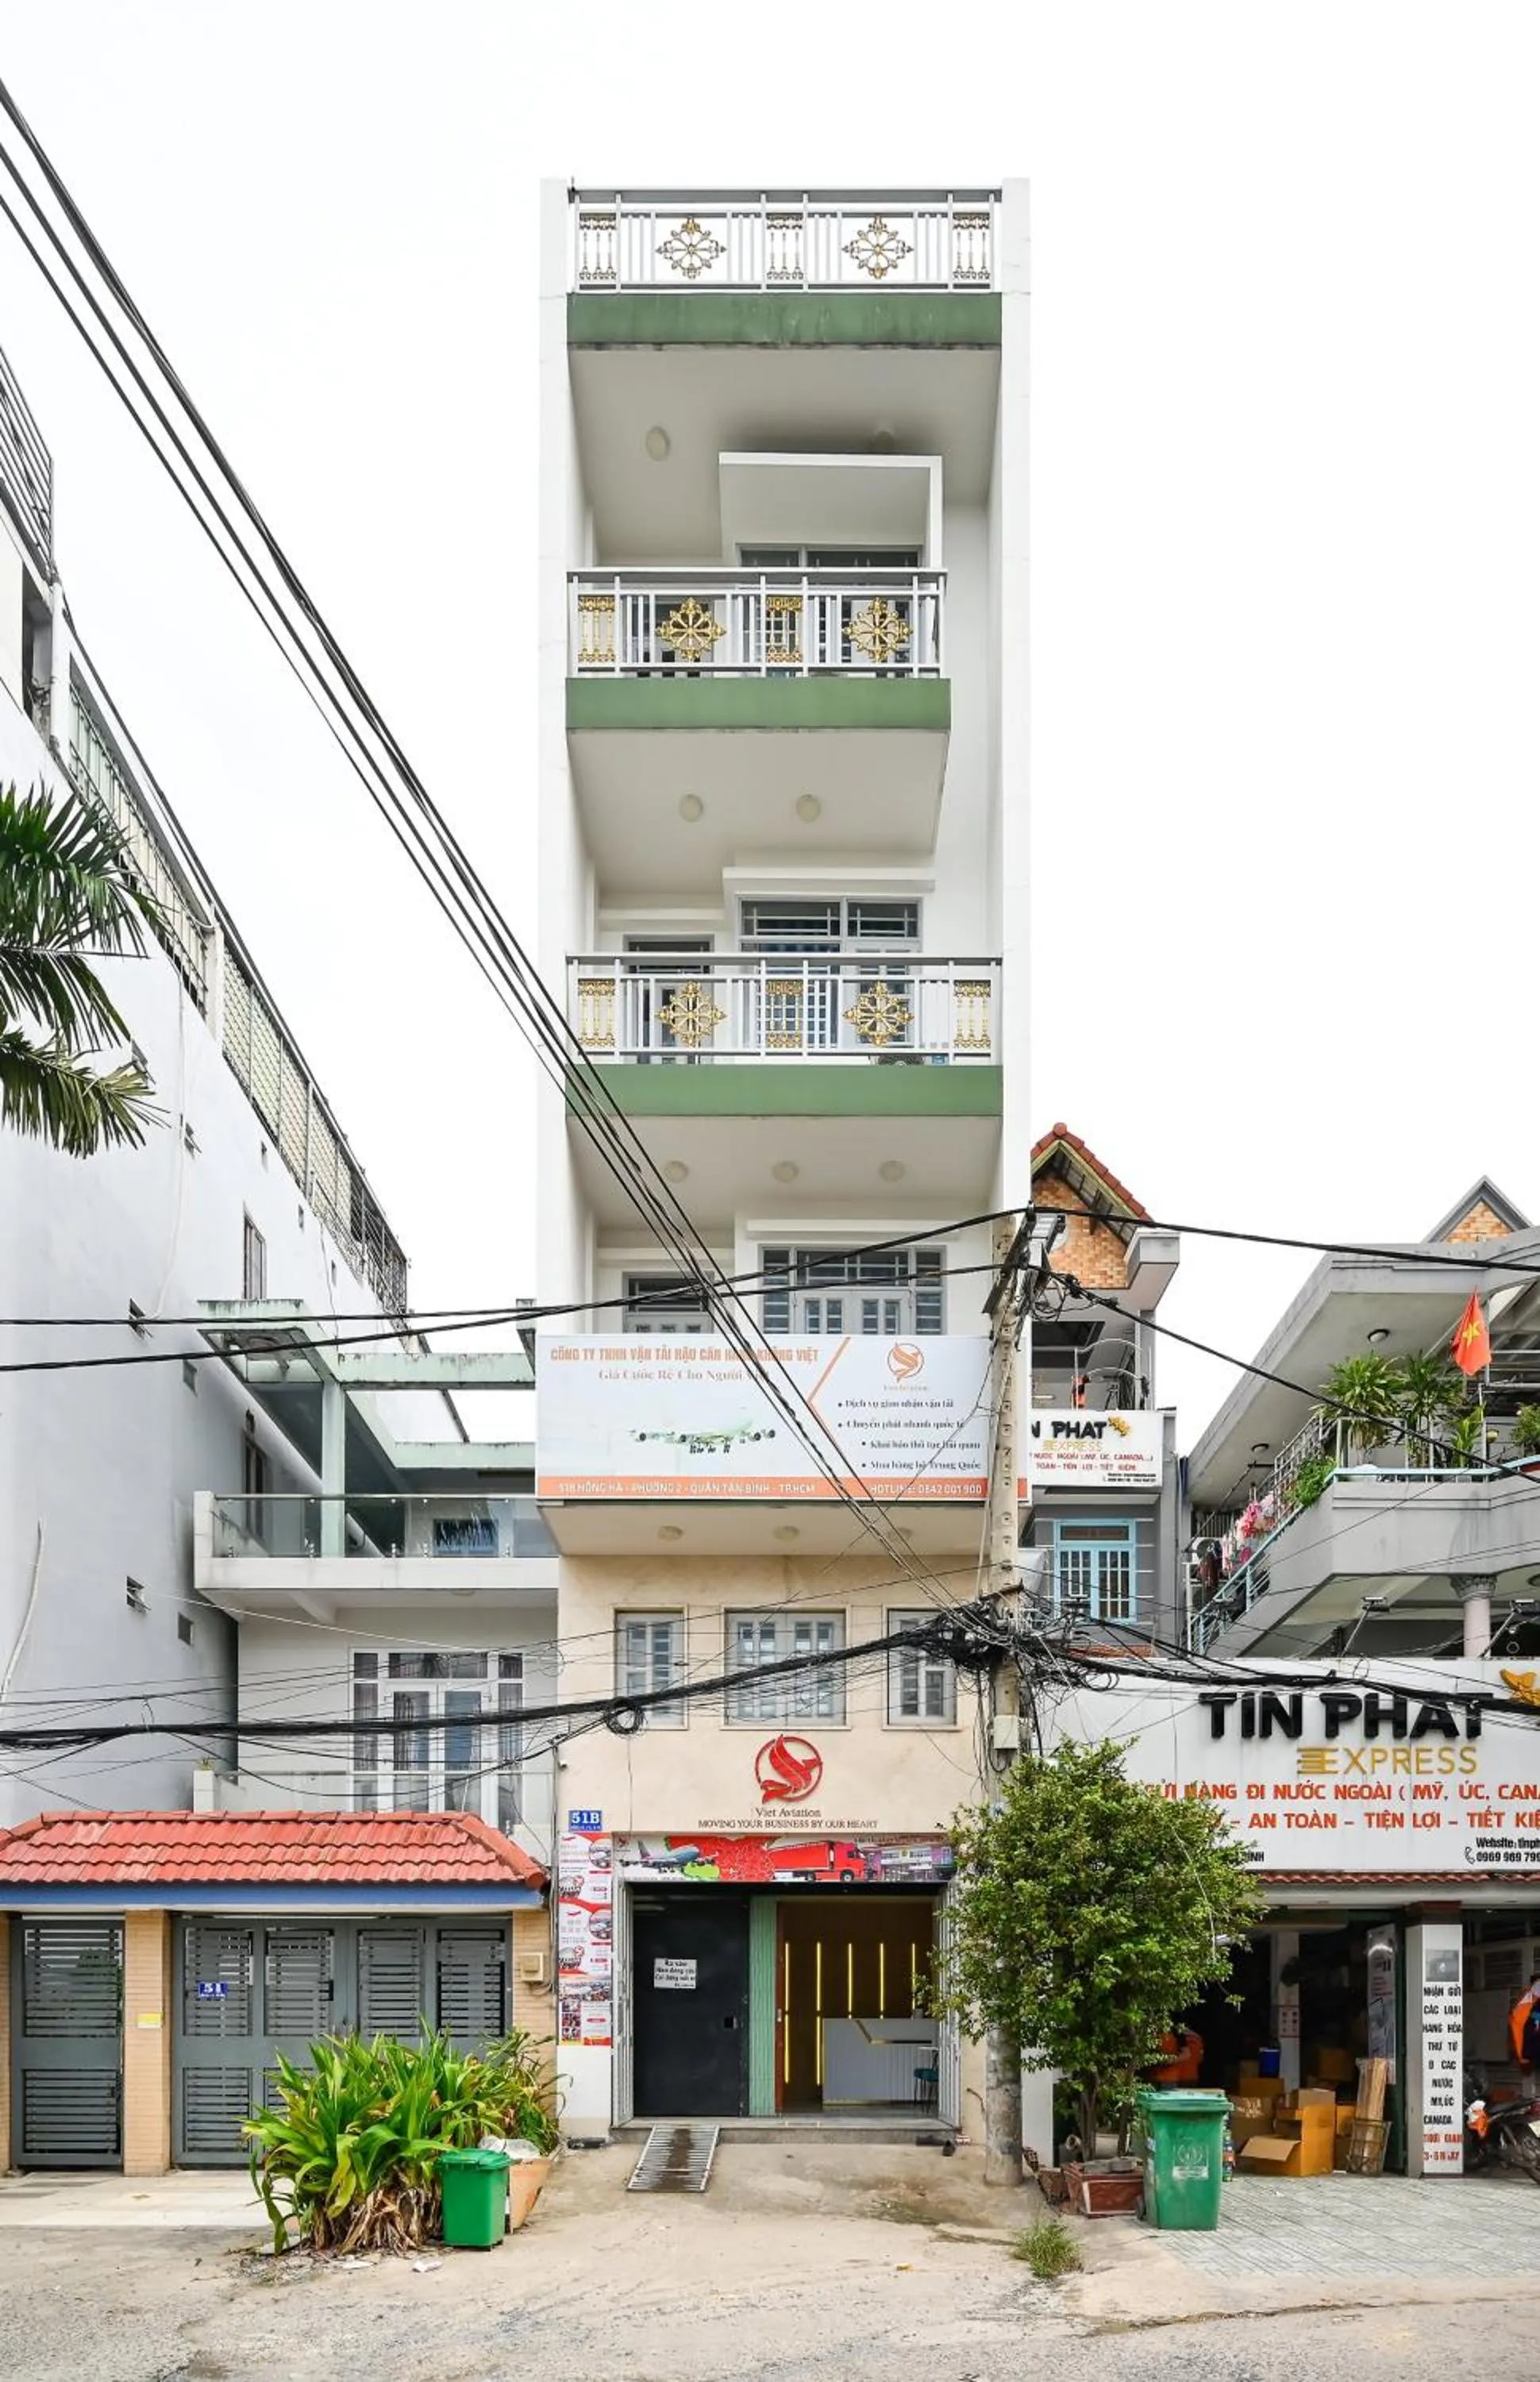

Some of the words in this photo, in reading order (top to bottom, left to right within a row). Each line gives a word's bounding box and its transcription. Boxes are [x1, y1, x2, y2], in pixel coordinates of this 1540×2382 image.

[1051, 1420, 1107, 1439] PHAT
[1296, 1747, 1478, 1775] EXPRESS
[1245, 1784, 1265, 1800] ĐI
[1273, 1779, 1326, 1800] NƯỚC
[1334, 1781, 1392, 1800] NGOÀI
[1497, 1784, 1540, 1800] CAN
[572, 1811, 599, 1824] 51B
[698, 1819, 736, 1829] MOVING
[738, 1819, 763, 1829] YOUR
[1249, 1812, 1277, 1829] AN
[1284, 1808, 1338, 1829] TOÀN
[1365, 1809, 1405, 1832] TIỆN
[1412, 1810, 1442, 1832] LỢI
[1467, 1805, 1506, 1829] TIẾT
[1476, 1852, 1501, 1862] 0969
[1503, 1852, 1522, 1862] 969
[204, 1983, 221, 1994] 51
